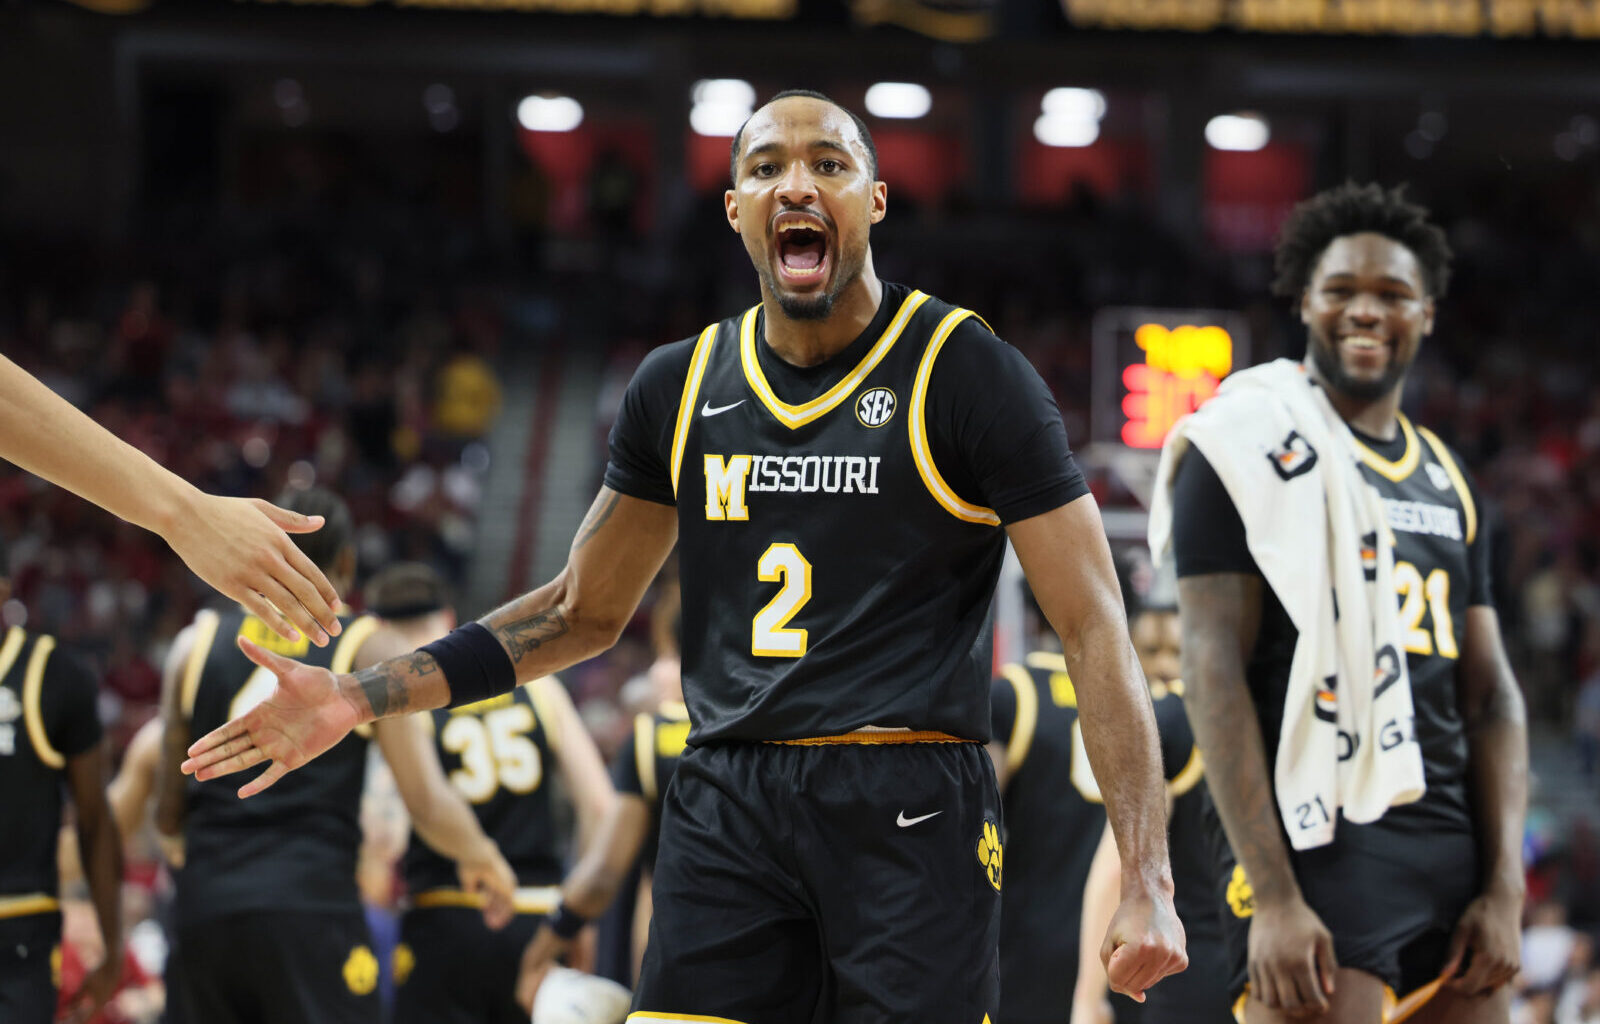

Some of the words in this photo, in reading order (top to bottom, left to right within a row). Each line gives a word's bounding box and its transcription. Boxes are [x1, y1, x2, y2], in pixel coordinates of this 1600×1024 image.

[859, 390, 894, 425] SEC
[704, 454, 881, 521] MISSOURI
[751, 542, 813, 658] 2
[1393, 561, 1459, 660] 21
[441, 702, 543, 805] 35
[1296, 794, 1330, 830] 21
